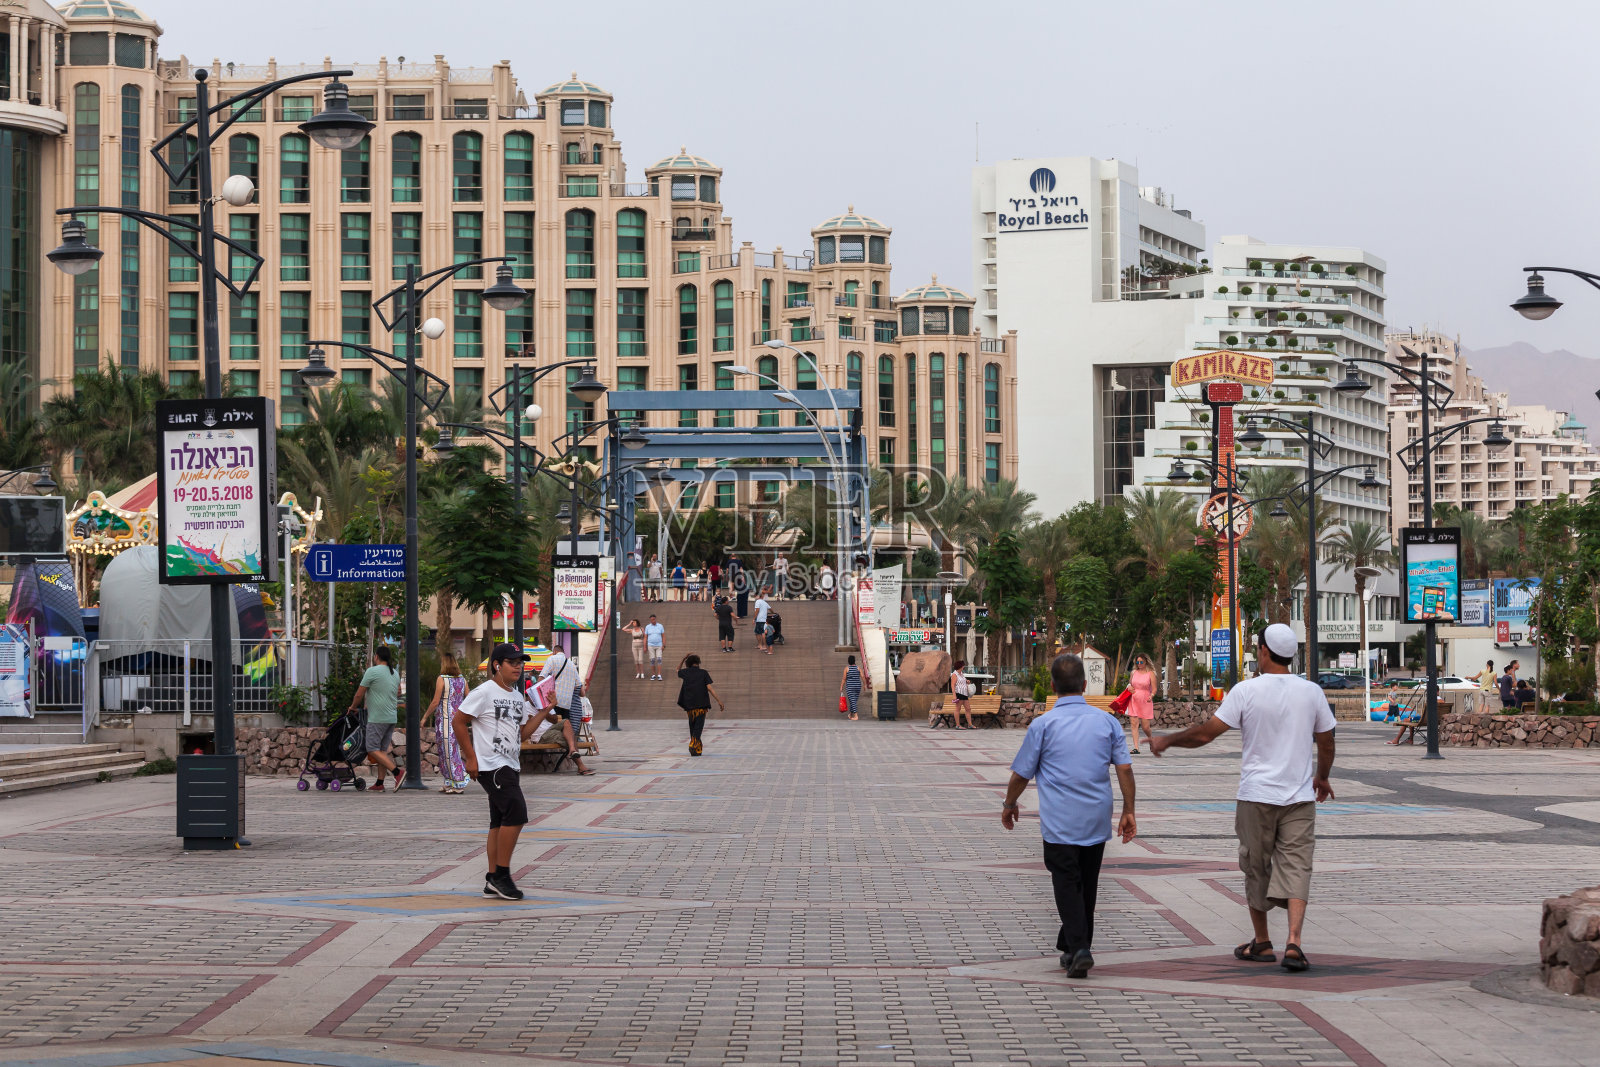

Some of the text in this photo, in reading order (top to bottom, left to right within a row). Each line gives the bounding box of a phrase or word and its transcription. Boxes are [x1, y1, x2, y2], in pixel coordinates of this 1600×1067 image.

[1041, 195, 1078, 207] רויאל
[999, 209, 1088, 230] Royal Beach
[1178, 354, 1271, 381] KAMIKAZE
[168, 413, 198, 424] EILAT
[223, 408, 254, 422] אילת
[170, 442, 254, 471] הביאנלה
[173, 485, 254, 502] 19-20.5.2018
[184, 520, 245, 531] הכניסה חופשית
[364, 549, 404, 559] מודיעין
[337, 568, 405, 578] Information
[565, 574, 592, 583] Biennale
[40, 573, 58, 585] MAX
[55, 580, 73, 591] Flight
